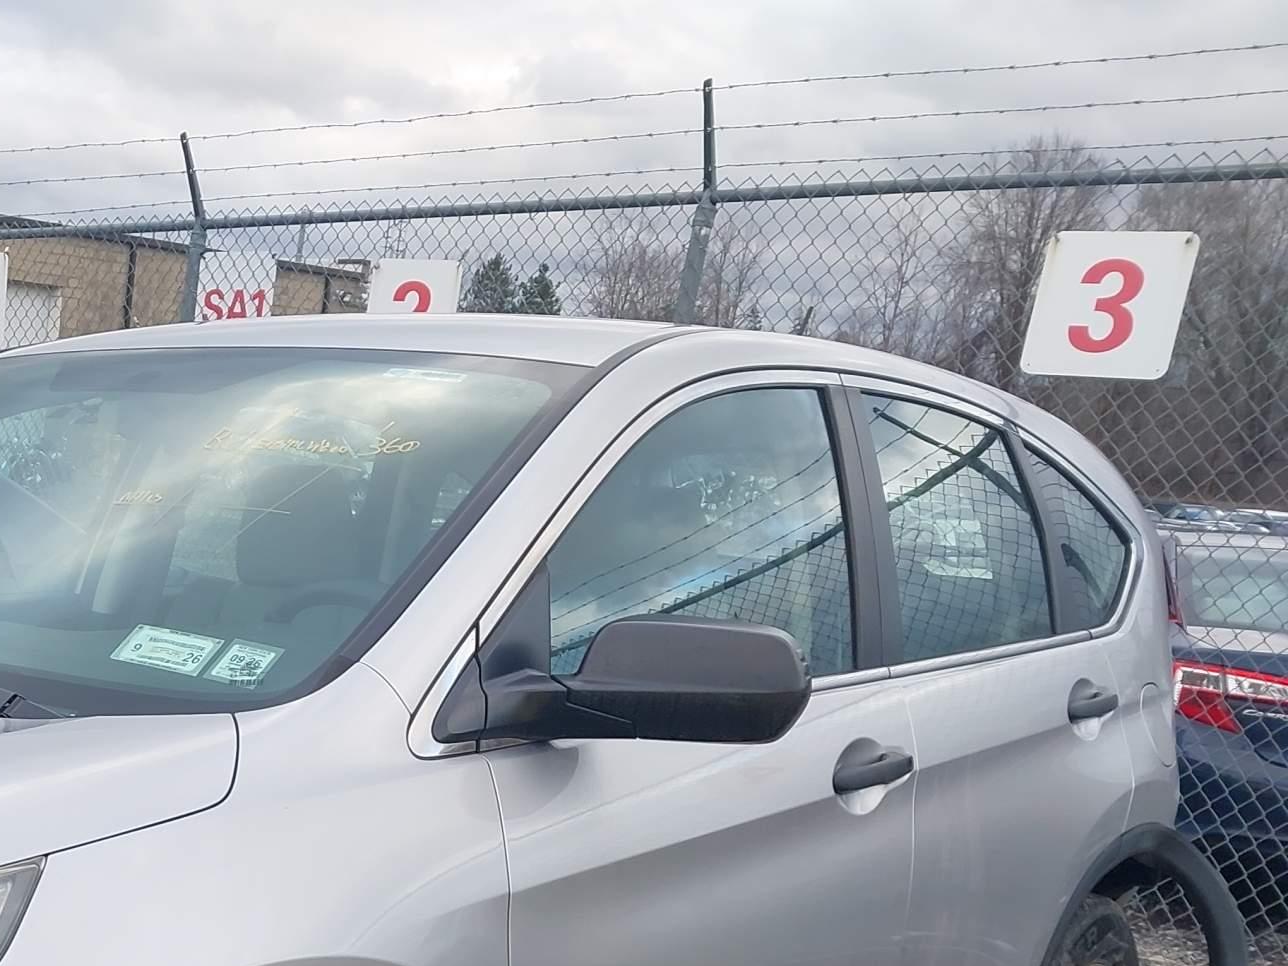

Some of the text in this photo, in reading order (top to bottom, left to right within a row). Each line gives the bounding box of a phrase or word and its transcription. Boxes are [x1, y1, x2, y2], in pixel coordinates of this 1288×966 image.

[203, 288, 267, 321] SA1
[1066, 257, 1146, 354] 3
[131, 642, 143, 653] 9
[181, 651, 203, 665] 26
[229, 653, 246, 665] 09
